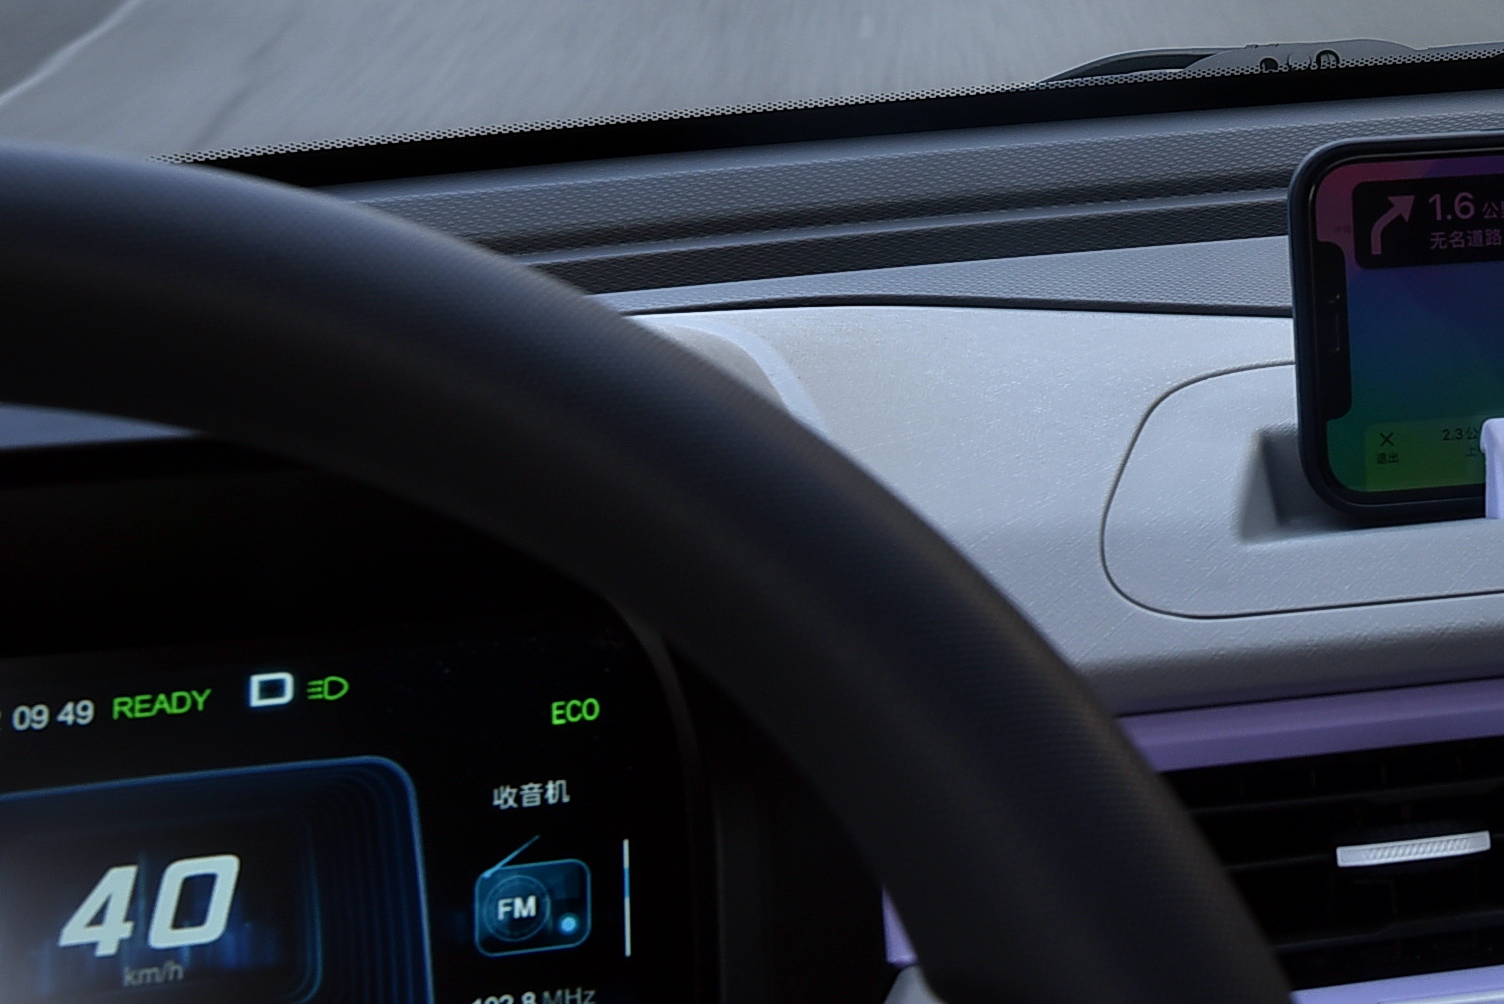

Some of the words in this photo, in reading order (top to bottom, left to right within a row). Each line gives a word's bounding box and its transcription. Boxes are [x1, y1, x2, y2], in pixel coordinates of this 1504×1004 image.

[1429, 192, 1475, 221] 1.6
[1430, 228, 1502, 250] 无名道路
[1442, 426, 1479, 441] 2.3公
[250, 672, 294, 707] D
[113, 689, 211, 720] READY
[551, 698, 600, 725] ECO
[492, 779, 571, 810] 收音机
[58, 854, 240, 958] 40
[497, 895, 537, 921] FM
[124, 961, 185, 987] km/h
